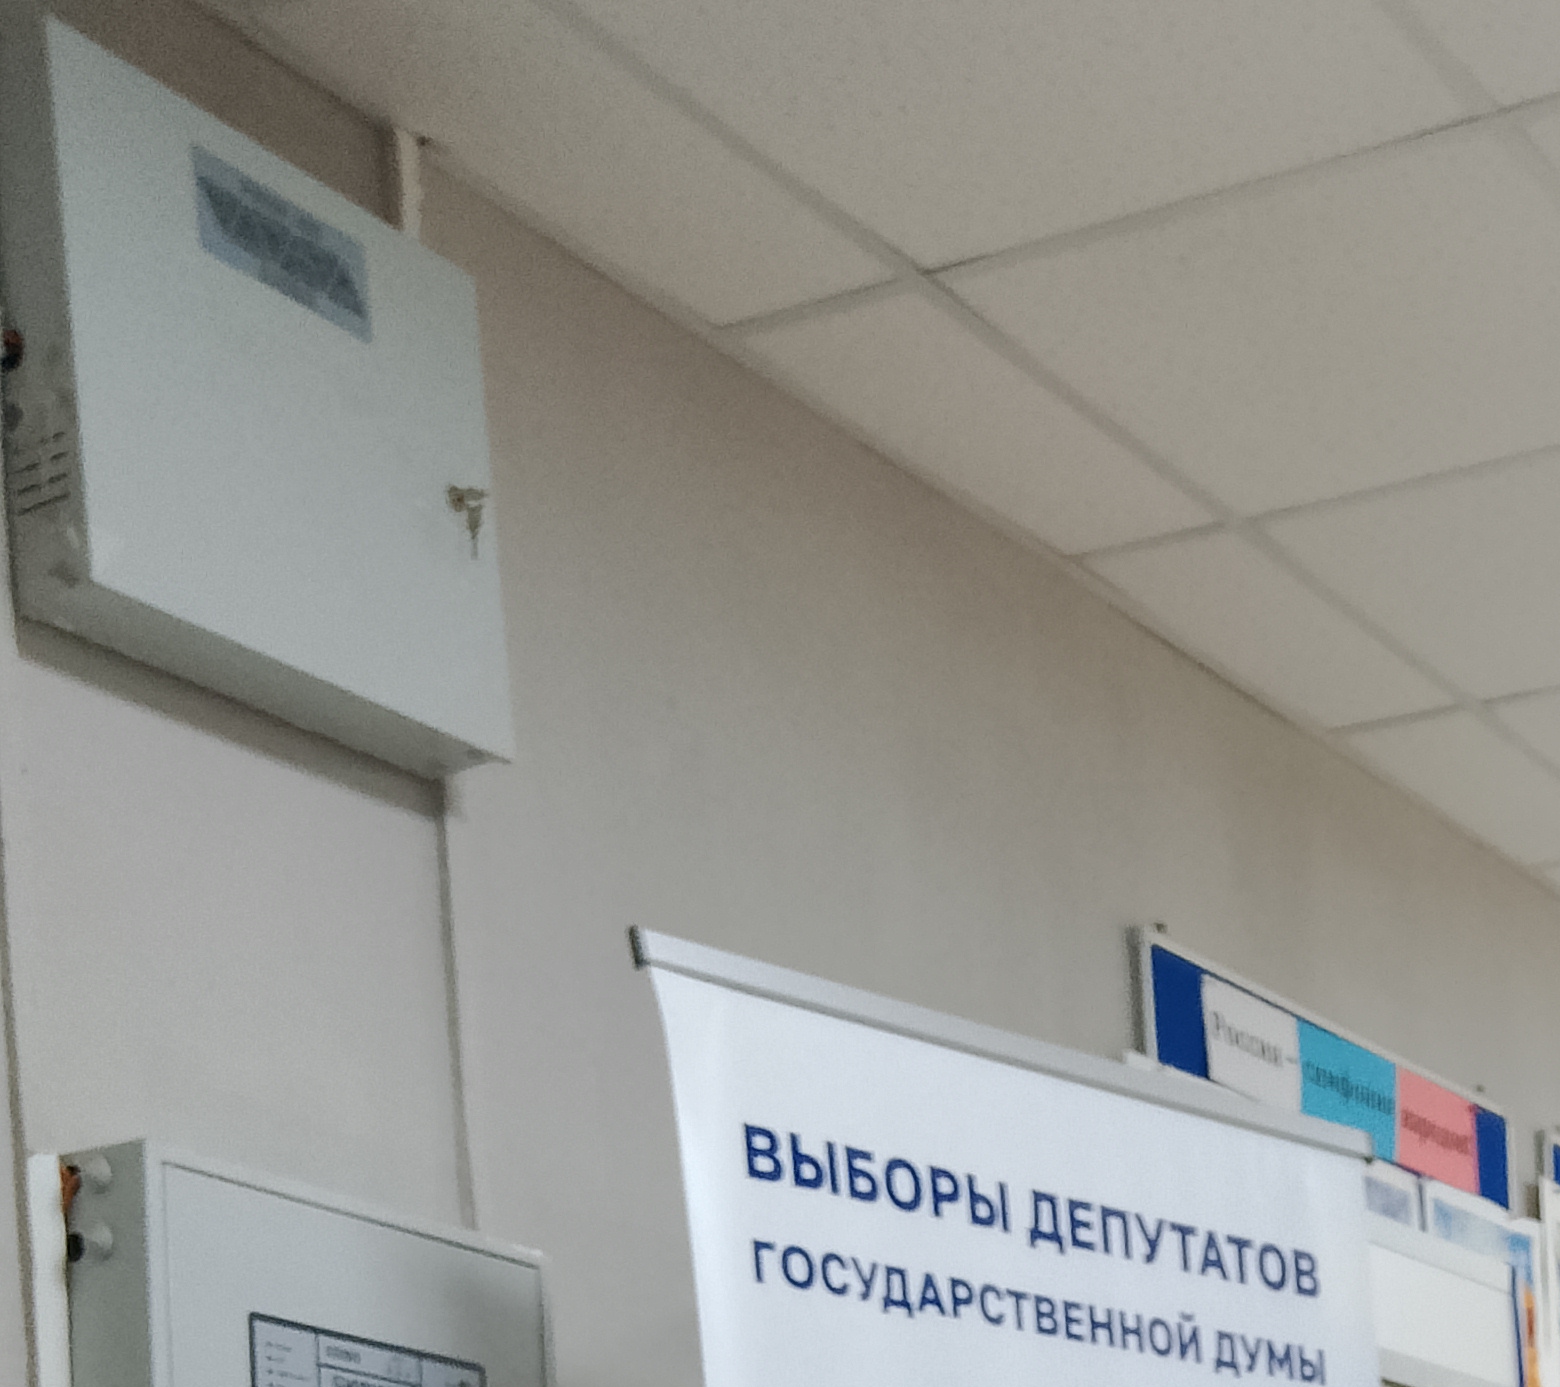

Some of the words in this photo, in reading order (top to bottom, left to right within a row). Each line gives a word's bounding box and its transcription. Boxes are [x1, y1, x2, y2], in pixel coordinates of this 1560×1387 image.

[743, 1123, 1010, 1232] ВЫБОРЫ
[1030, 1189, 1319, 1297] ДЕПУТАТОВ
[753, 1239, 1201, 1363] ГОСУДАРСТВЕННОЙ
[1214, 1330, 1326, 1386] ДУМЫ
